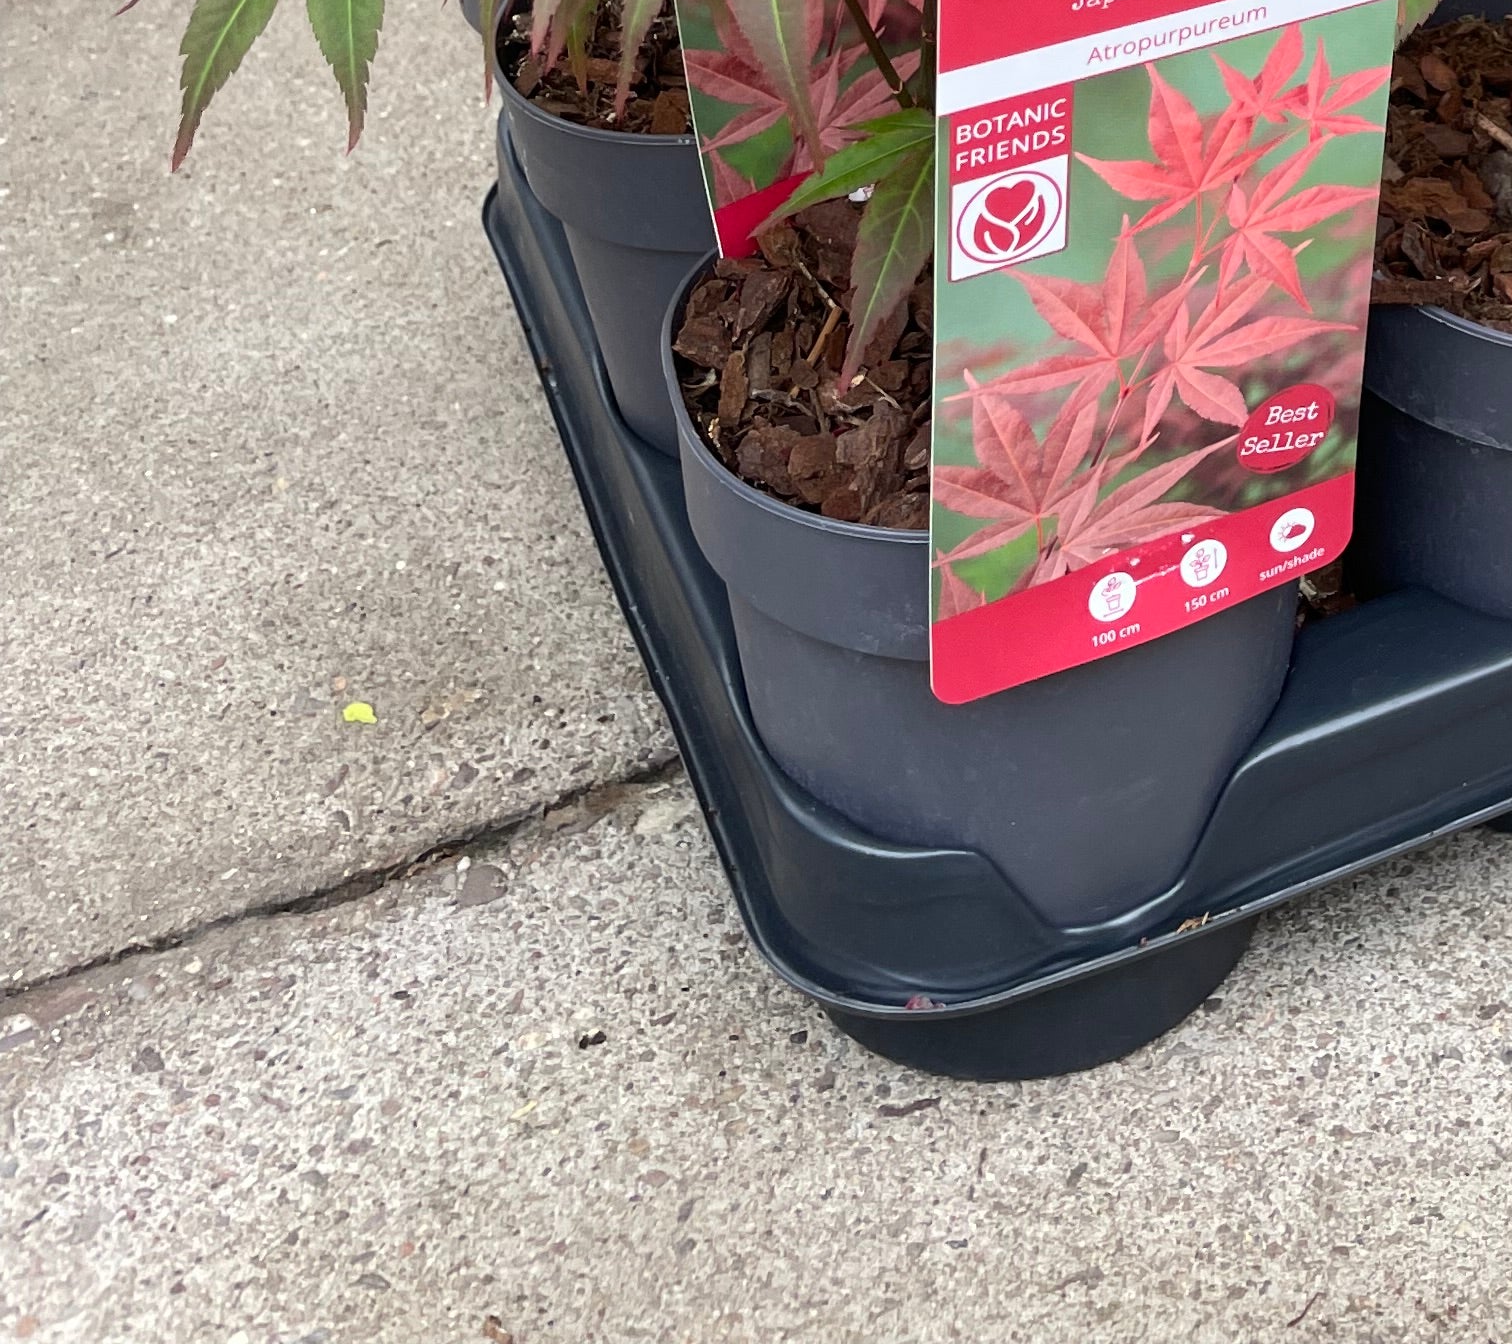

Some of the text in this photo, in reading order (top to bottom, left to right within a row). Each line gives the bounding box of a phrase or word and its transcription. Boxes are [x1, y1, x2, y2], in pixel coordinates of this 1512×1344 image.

[1086, 5, 1268, 65] Atropurpureum
[955, 98, 1067, 145] BOTANIC
[955, 125, 1066, 172] FRIENDS
[1264, 401, 1319, 426] Best
[1240, 430, 1325, 457] Seller
[1258, 546, 1326, 582] sun/shade
[1184, 586, 1230, 613] 150 cm
[1091, 622, 1141, 648] 100 cm
